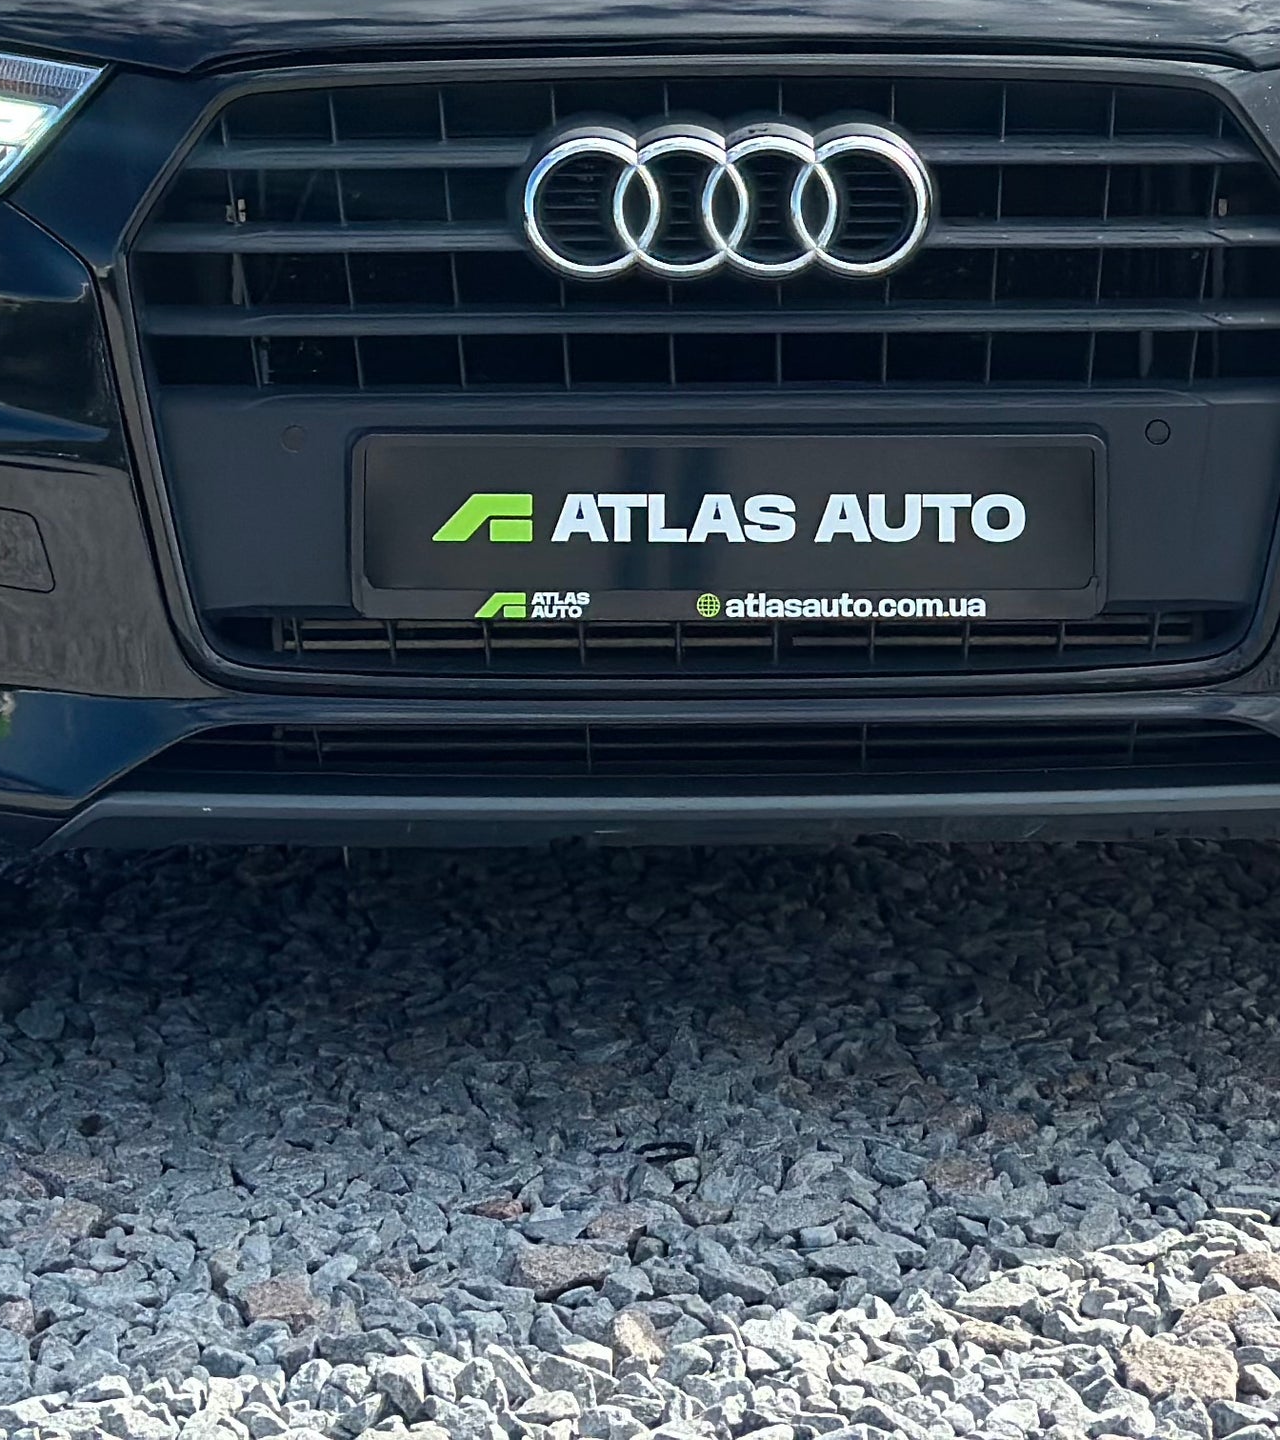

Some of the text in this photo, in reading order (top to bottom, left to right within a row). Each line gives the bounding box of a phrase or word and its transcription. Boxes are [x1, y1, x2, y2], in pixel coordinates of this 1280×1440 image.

[550, 493, 1026, 544] ATLAS AUTO
[530, 591, 591, 606] ATLAS
[724, 592, 988, 619] atlasauto.com.ua
[530, 605, 583, 619] AUTO
